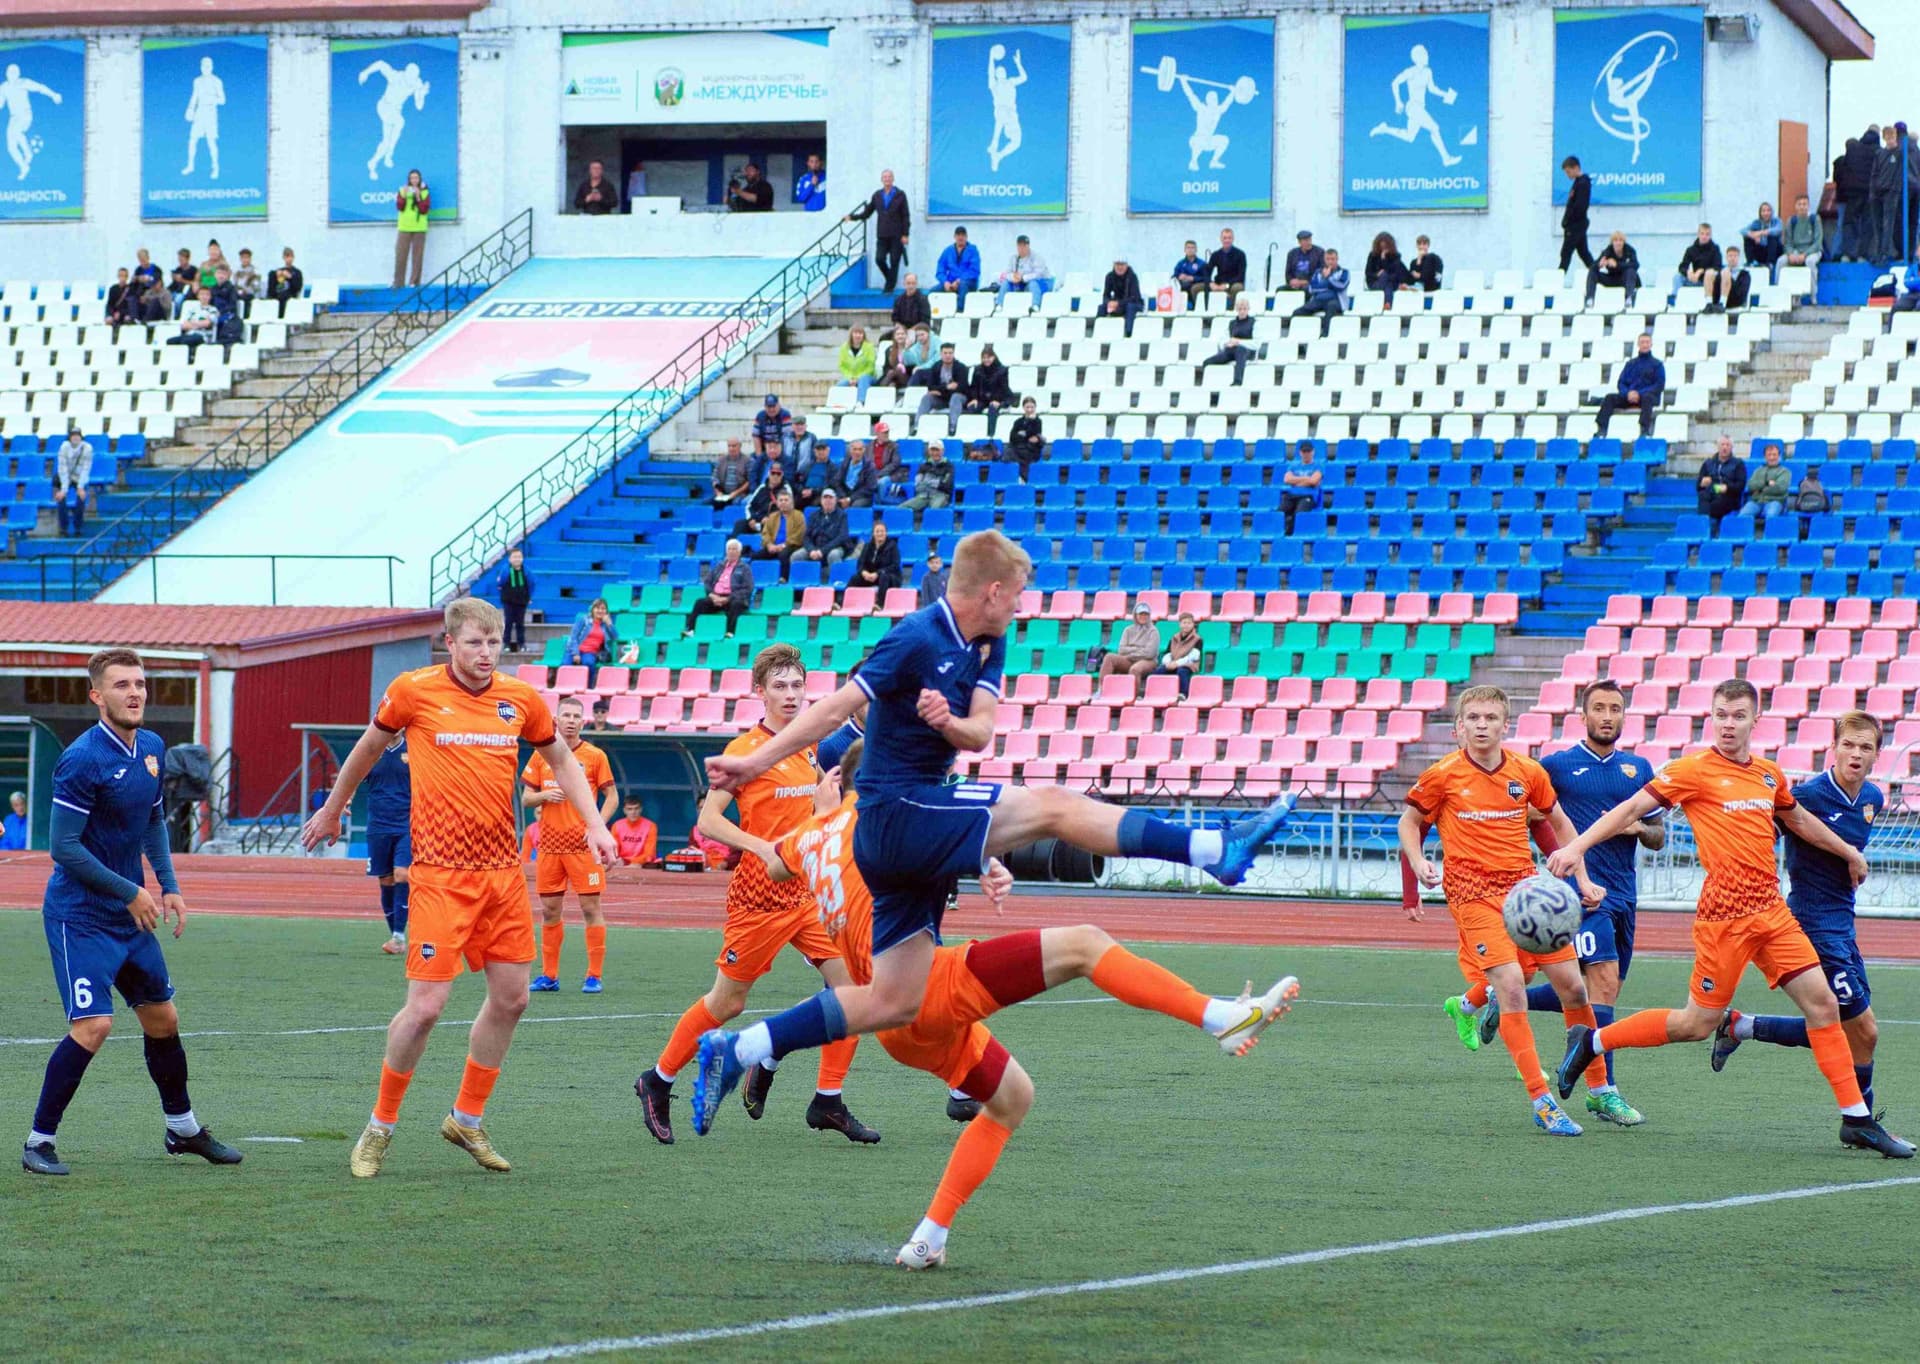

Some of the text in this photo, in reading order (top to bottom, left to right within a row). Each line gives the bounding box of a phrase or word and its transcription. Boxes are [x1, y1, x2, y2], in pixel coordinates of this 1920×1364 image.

[692, 83, 829, 102] «МЕЖДУРЕЧЬЕ»
[962, 184, 1033, 197] МЕТКОСТЬ
[1182, 181, 1220, 194] ВОЛЯ
[1352, 176, 1481, 191] ВНИМАТЕЛЬНОСТЬ
[0, 188, 67, 203] АНДНОСТЬ
[774, 783, 818, 799] ПРОДИН
[1575, 931, 1597, 959] 10
[74, 977, 93, 1009] 6
[1833, 971, 1853, 999] 5
